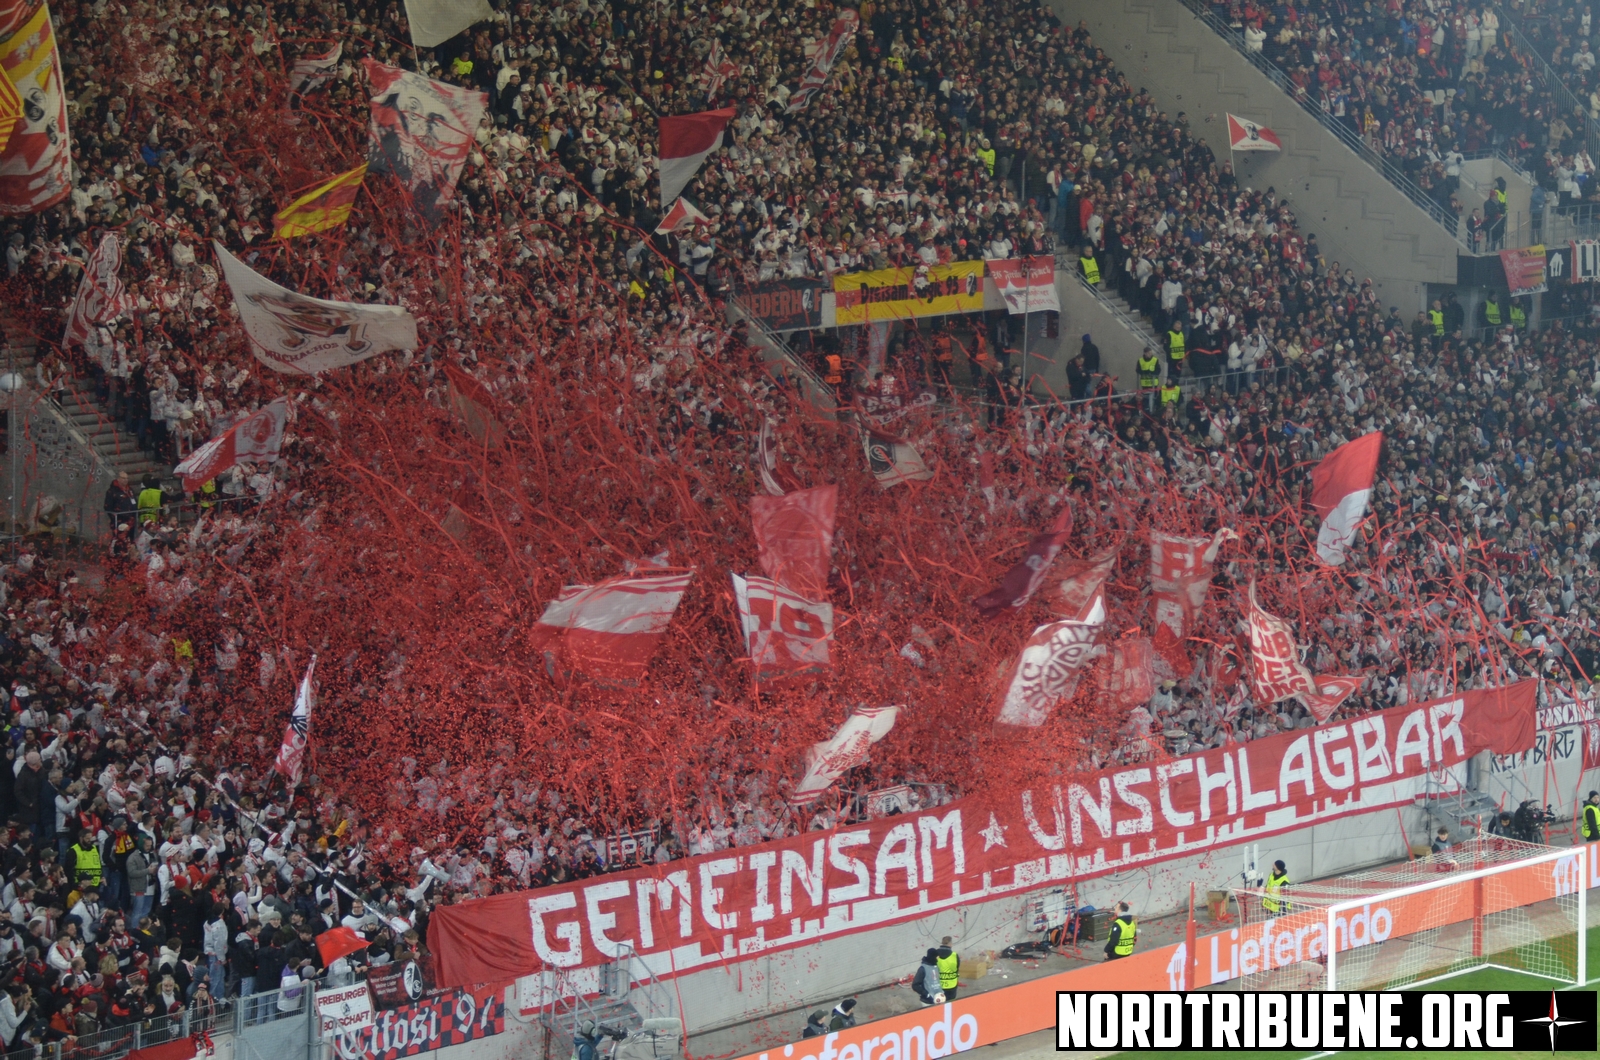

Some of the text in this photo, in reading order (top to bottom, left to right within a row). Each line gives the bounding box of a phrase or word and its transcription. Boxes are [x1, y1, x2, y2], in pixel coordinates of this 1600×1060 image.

[861, 282, 908, 304] Dreisam
[945, 275, 959, 297] 95
[264, 342, 339, 362] MUCHACHOS
[1022, 698, 1465, 852] UNSCHLAGBAR
[528, 809, 965, 968] GEMEINSAM
[1210, 904, 1393, 984] Lieferando
[318, 986, 367, 1007] FREIBURGER
